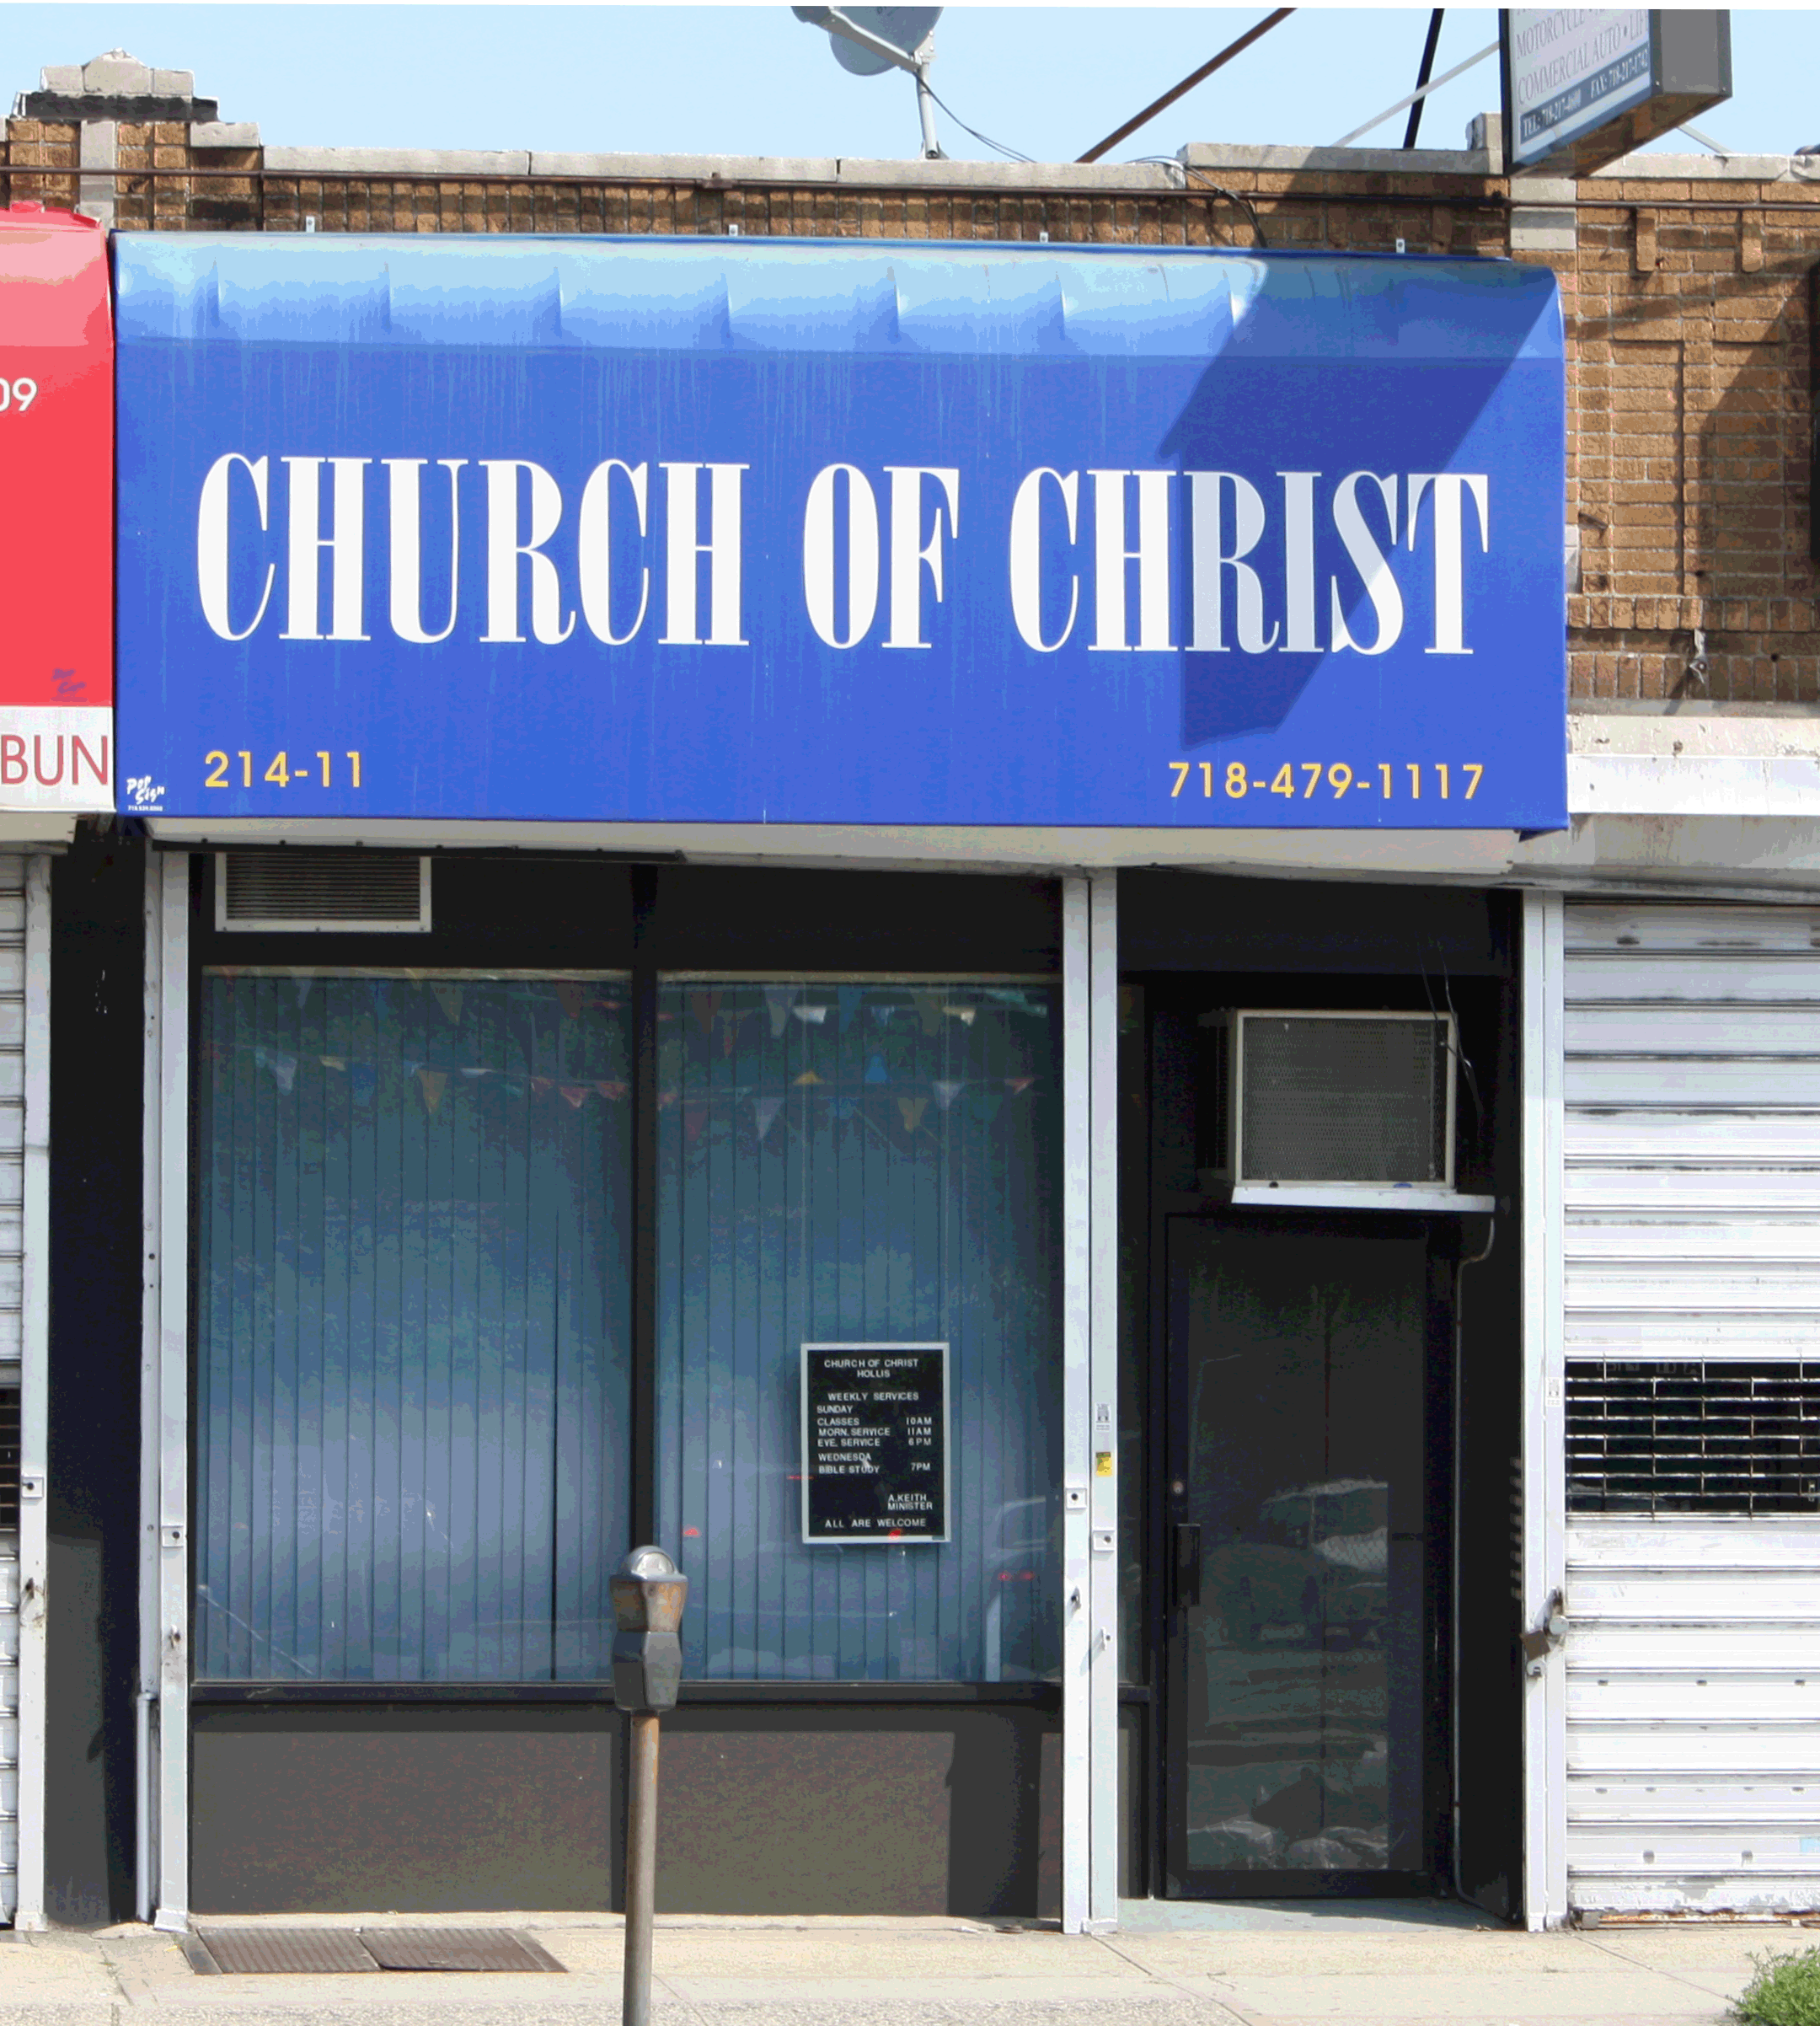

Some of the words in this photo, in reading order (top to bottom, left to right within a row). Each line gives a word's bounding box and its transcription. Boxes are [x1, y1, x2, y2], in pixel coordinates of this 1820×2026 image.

[1517, 9, 1585, 60] MOTORCYCLE
[1518, 42, 1590, 105] COMMERCIAL
[1592, 23, 1620, 65] AUTO
[198, 453, 750, 646] CHURCH
[803, 464, 959, 649] OF
[1009, 467, 1489, 655] CHRIST
[0, 734, 109, 785] BUN
[205, 750, 360, 787] 214-11
[1170, 762, 1483, 799] 718-479-1117
[824, 1359, 865, 1368] CHURCH
[867, 1359, 881, 1367] OF
[884, 1358, 918, 1367] CHRIST
[857, 1369, 891, 1378] HOLLIS
[827, 1392, 869, 1401] WEEKLY
[873, 1391, 919, 1401] SERVICES
[816, 1405, 854, 1413] SUNDAY
[816, 1417, 859, 1426] CLASSES
[906, 1417, 932, 1425] 10AM
[850, 1427, 891, 1436] SERVICE
[907, 1427, 932, 1435] 11AM
[840, 1437, 881, 1446] SERVICE
[817, 1452, 872, 1461] WEDNESDA
[818, 1465, 845, 1474] BIBLE
[848, 1465, 881, 1474] STUDY
[911, 1462, 931, 1471] 7PM
[887, 1501, 933, 1510] MINISTER
[825, 1519, 844, 1528] ALL
[851, 1519, 872, 1527] ARE
[876, 1518, 927, 1527] WELCOME
